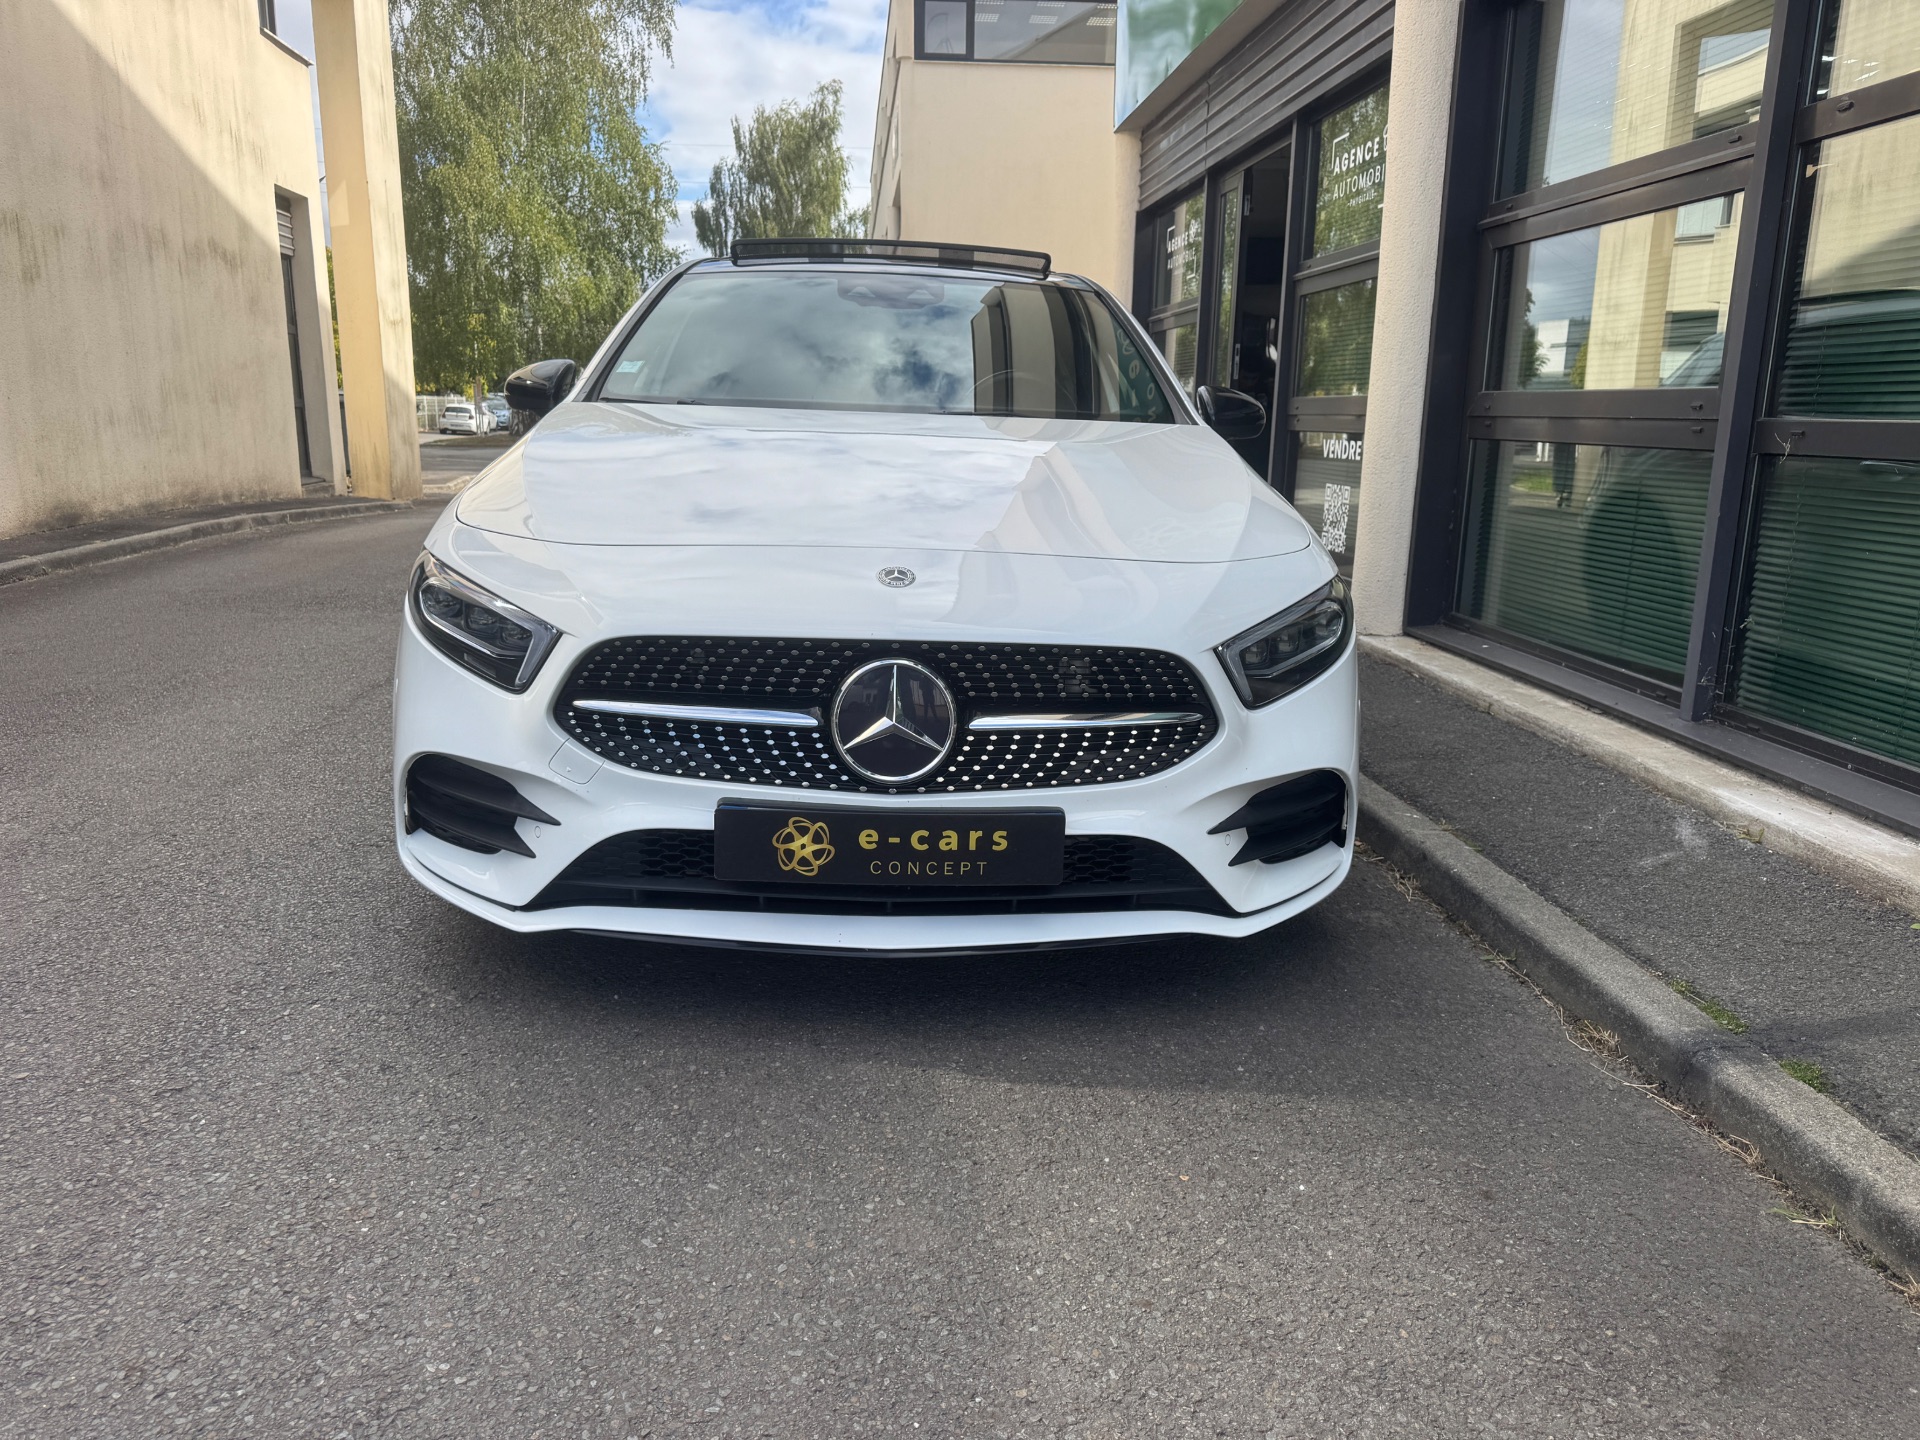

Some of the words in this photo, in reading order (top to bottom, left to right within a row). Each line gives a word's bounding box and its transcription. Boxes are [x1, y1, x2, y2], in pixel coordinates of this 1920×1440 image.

[1333, 136, 1380, 176] AGENCE
[1332, 163, 1385, 201] AUTOMOBI
[1167, 231, 1189, 254] AGENCE
[1323, 438, 1363, 461] VENDRE
[858, 828, 1009, 852] e-cars
[870, 860, 989, 876] CONCEPT
